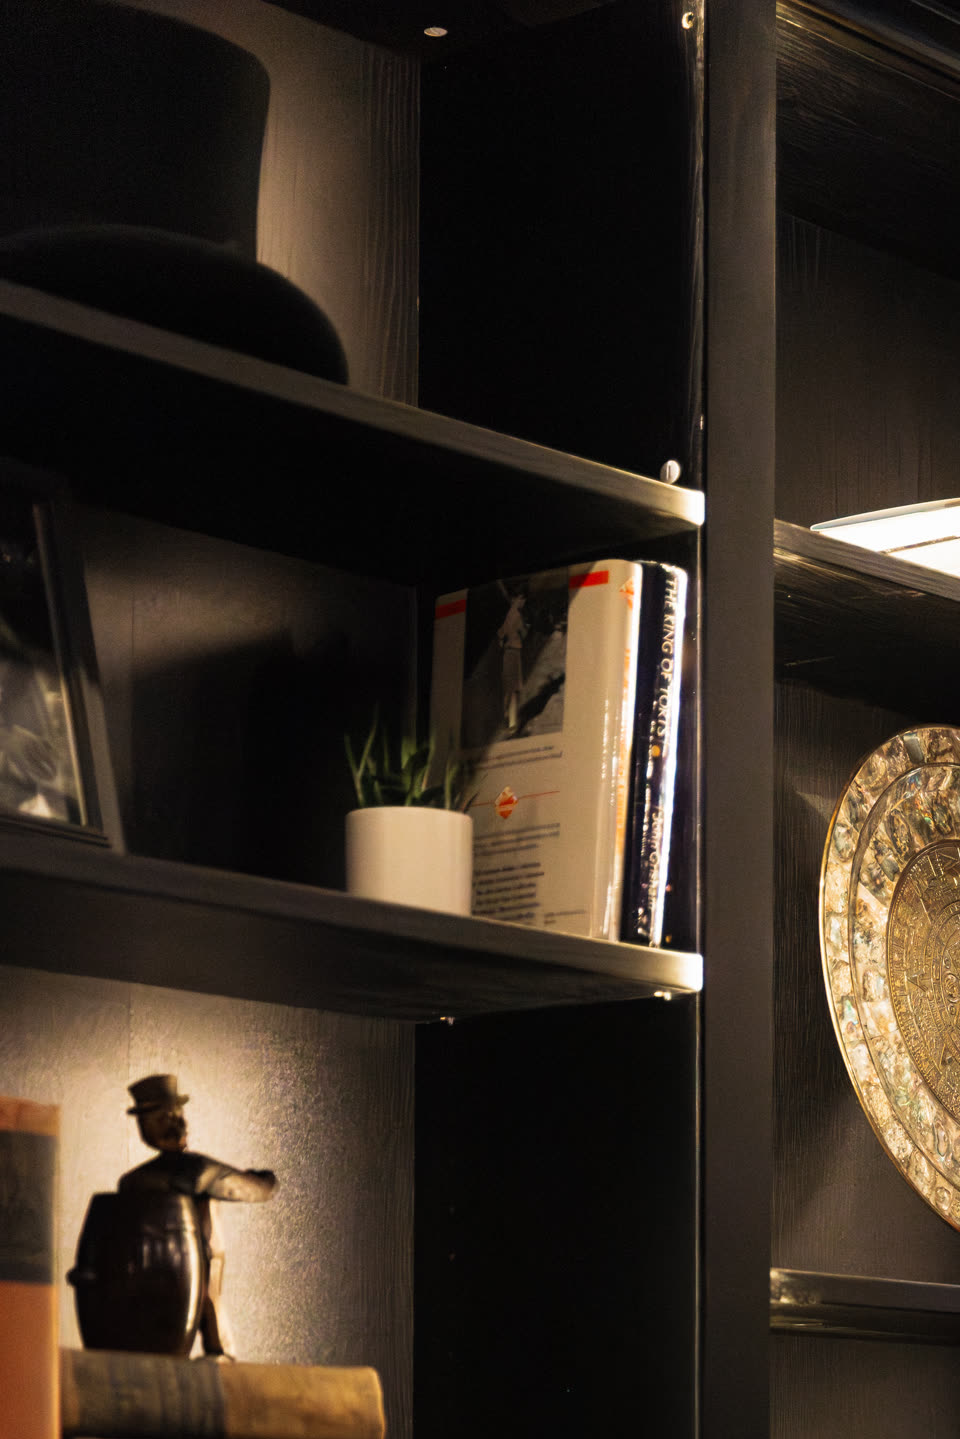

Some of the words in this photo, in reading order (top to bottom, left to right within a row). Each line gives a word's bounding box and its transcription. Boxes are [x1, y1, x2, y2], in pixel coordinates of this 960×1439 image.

[664, 579, 678, 609] THE
[661, 614, 677, 654] KING
[660, 657, 674, 682] OF
